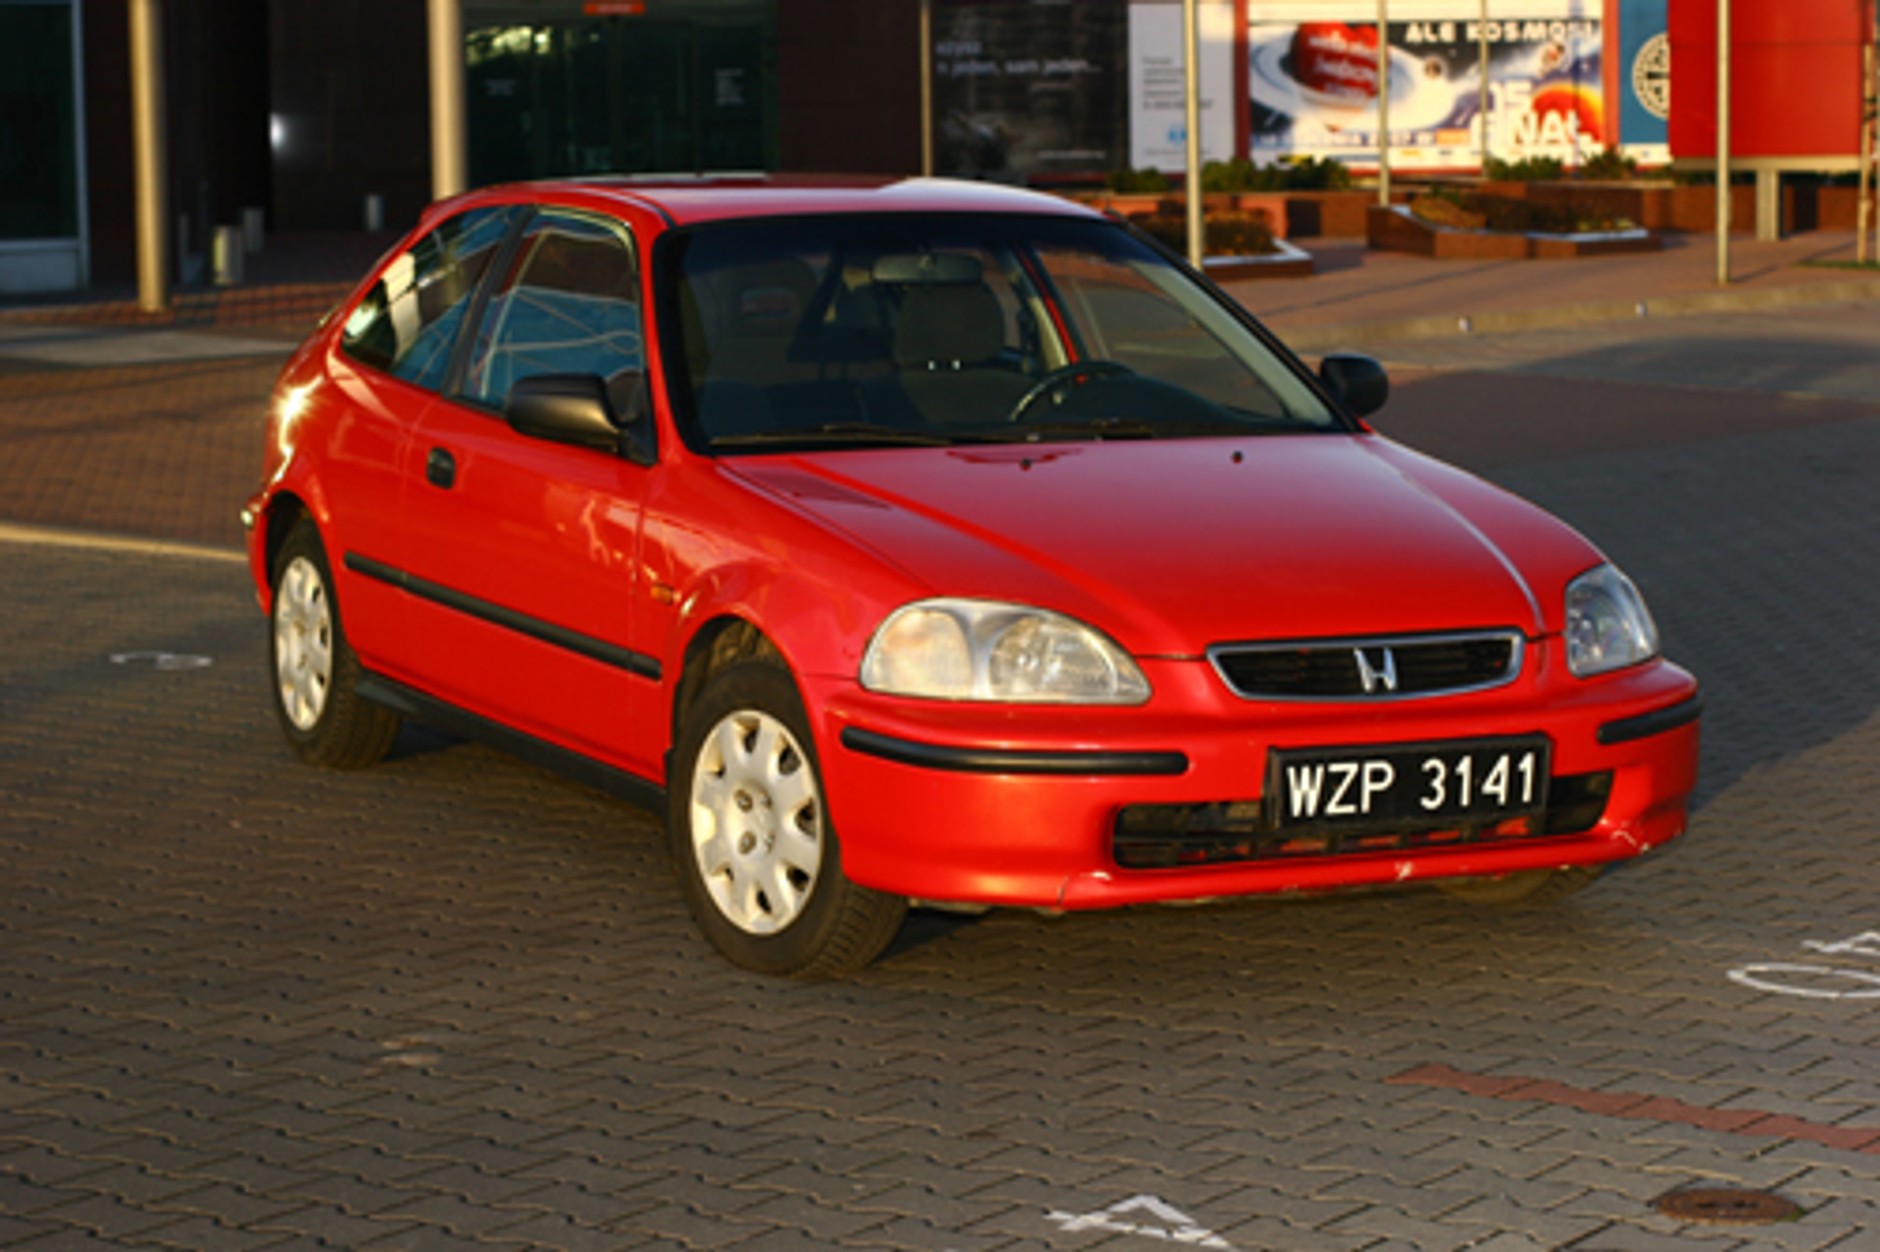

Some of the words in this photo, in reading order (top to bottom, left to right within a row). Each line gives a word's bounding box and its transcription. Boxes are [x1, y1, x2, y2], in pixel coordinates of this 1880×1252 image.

[1405, 21, 1456, 42] ALE
[1287, 759, 1395, 817] WZP
[1420, 752, 1535, 809] 3141
